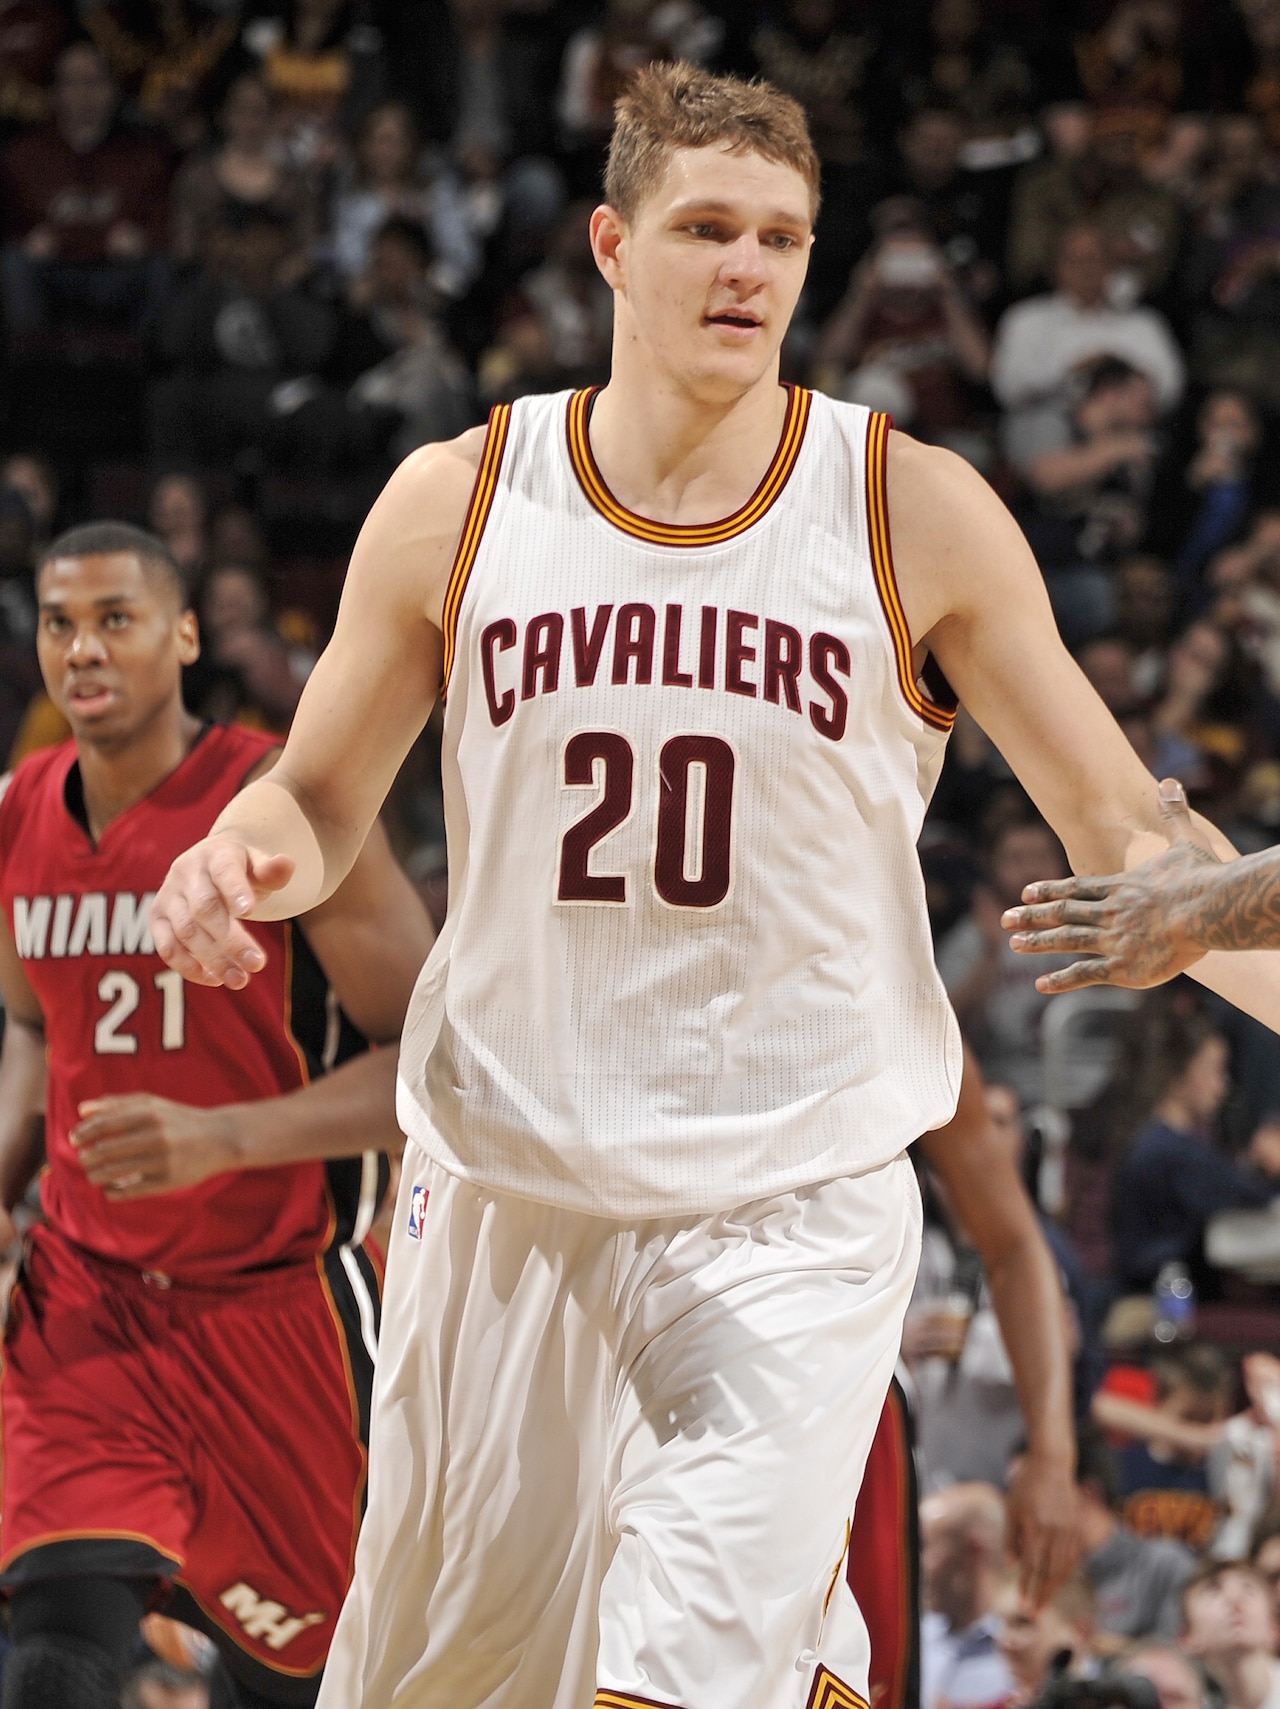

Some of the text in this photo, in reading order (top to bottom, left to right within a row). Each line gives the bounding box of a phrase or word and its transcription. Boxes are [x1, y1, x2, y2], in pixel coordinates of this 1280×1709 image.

[480, 603, 851, 742] CAVALIERS
[555, 729, 738, 909] 20
[12, 889, 163, 960] MIAM
[93, 968, 186, 1055] 21
